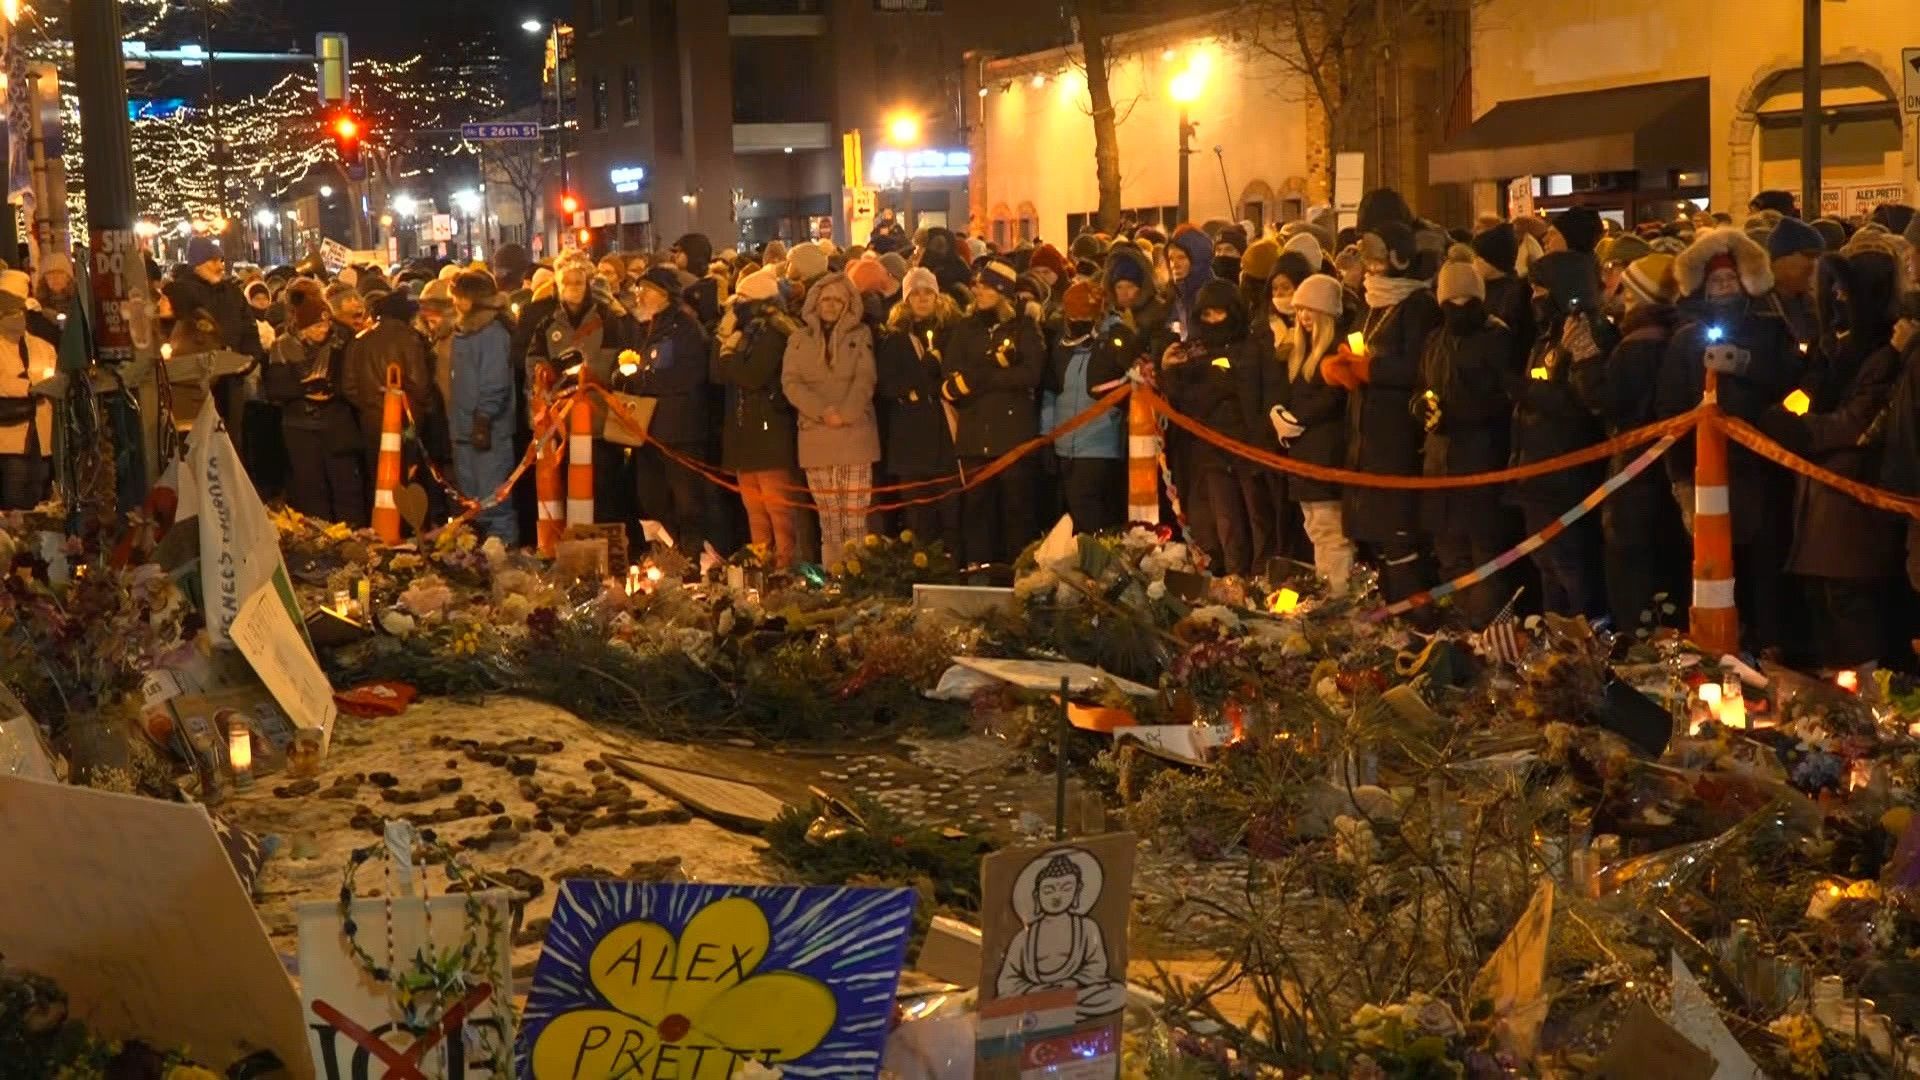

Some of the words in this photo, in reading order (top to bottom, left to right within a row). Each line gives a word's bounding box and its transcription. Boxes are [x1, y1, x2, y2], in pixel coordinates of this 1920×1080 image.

[1908, 95, 1920, 108] ON
[478, 126, 486, 137] E
[491, 126, 519, 137] 26th
[523, 126, 536, 137] St
[1856, 189, 1874, 200] ALEX
[1876, 187, 1901, 199] PRETTI
[605, 937, 755, 987] ALEX
